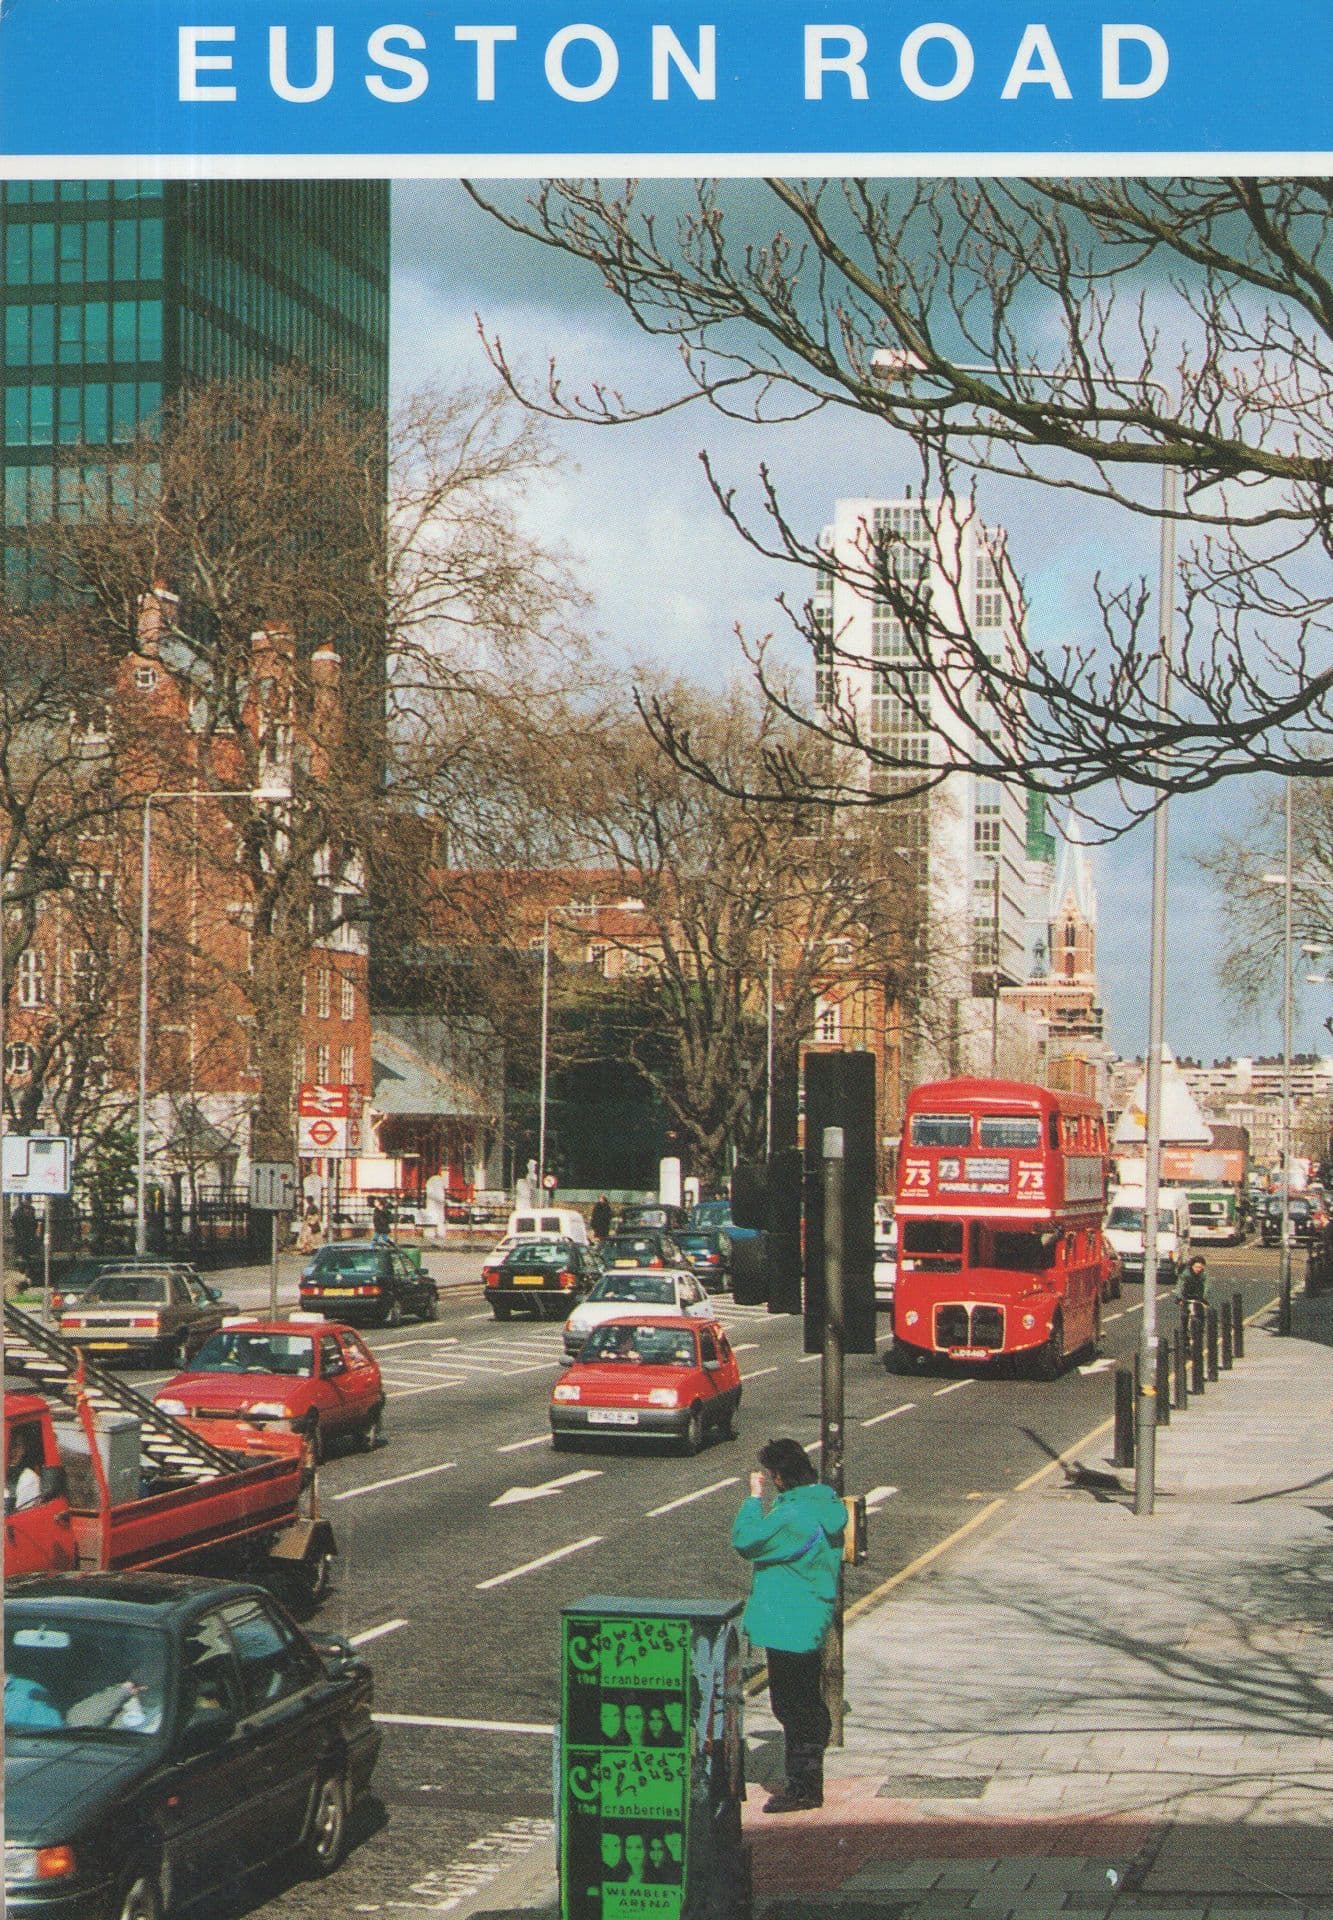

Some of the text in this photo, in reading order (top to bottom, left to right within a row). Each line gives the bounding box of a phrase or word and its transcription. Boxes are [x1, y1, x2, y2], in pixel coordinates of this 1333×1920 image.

[938, 1159, 960, 1178] 73
[905, 1168, 931, 1186] 73
[1017, 1170, 1044, 1188] 73
[603, 1675, 681, 1688] cranberries
[603, 1804, 681, 1817] cranberries
[607, 1887, 677, 1898] WEMBLEY
[619, 1898, 671, 1908] ARENA
